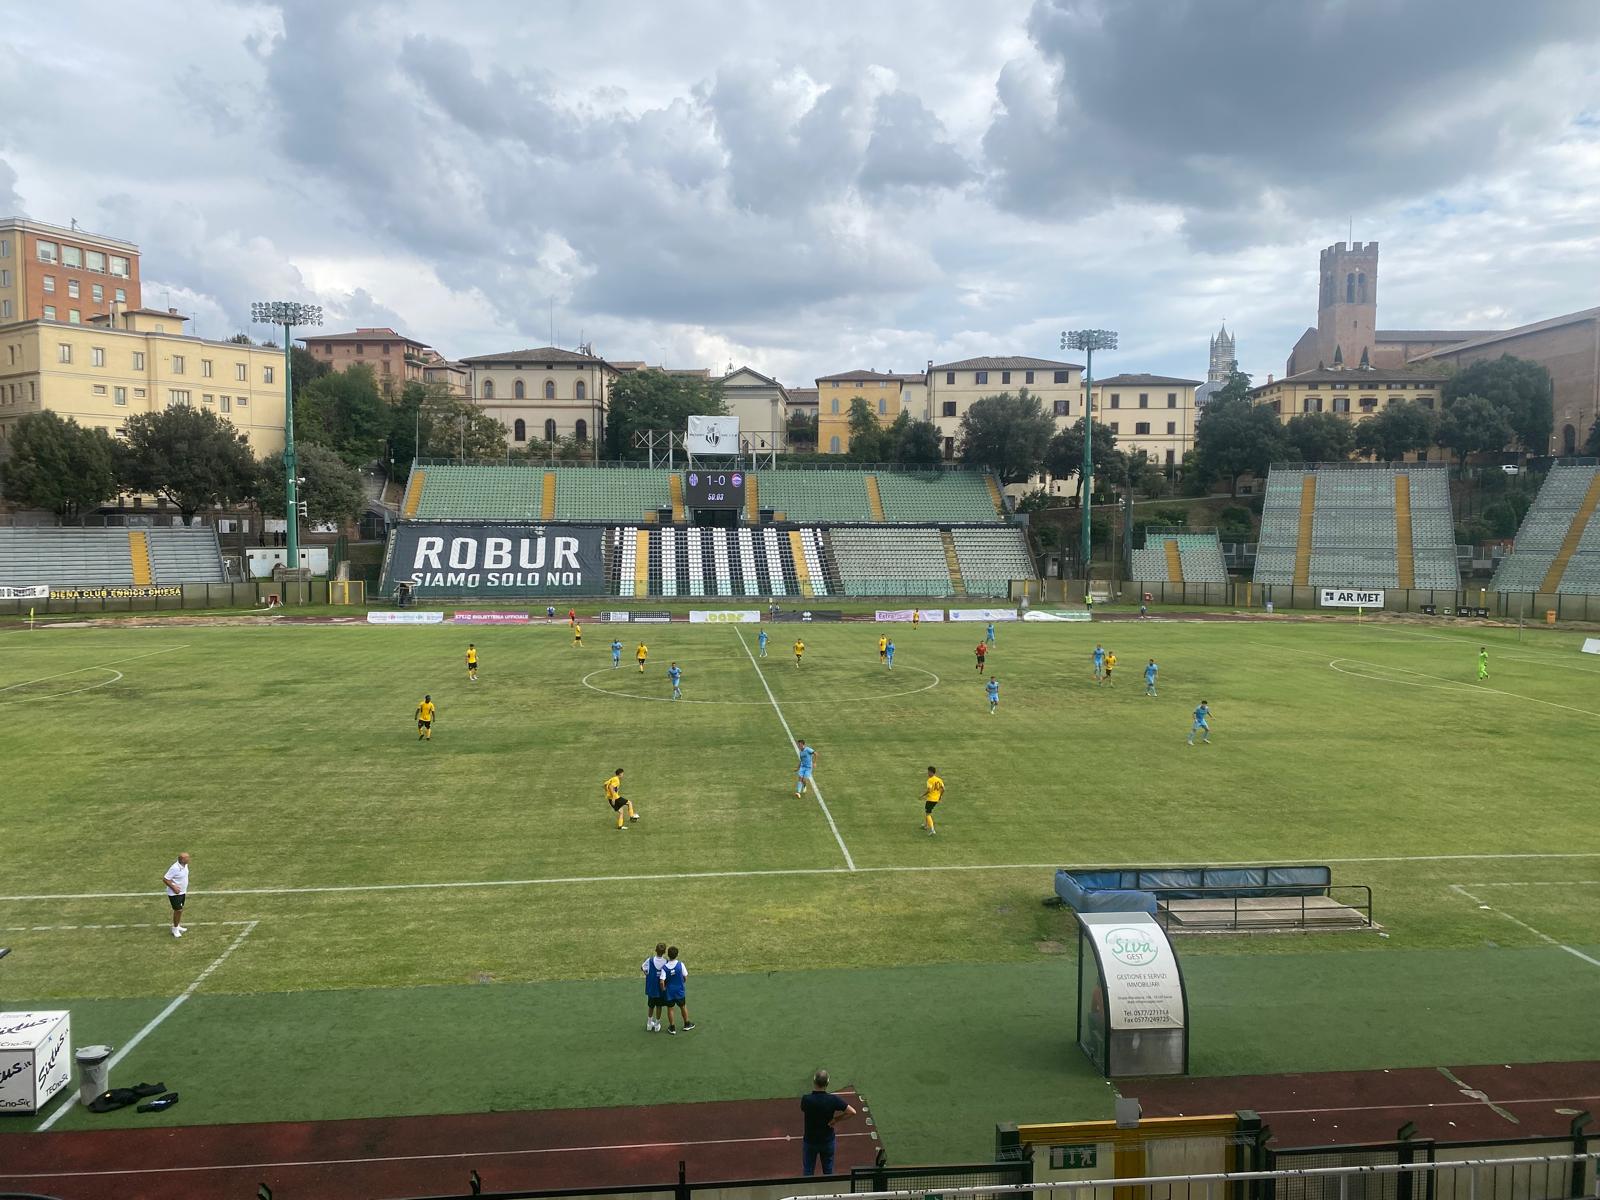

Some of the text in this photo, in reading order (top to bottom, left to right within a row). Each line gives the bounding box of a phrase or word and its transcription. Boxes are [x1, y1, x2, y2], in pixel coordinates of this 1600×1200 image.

[706, 475, 726, 486] 1-0
[413, 536, 580, 569] ROBUR
[410, 571, 582, 588] SIAMO SOLO NOI
[50, 586, 181, 599] SIENA CLUB ENRICO CHIESA
